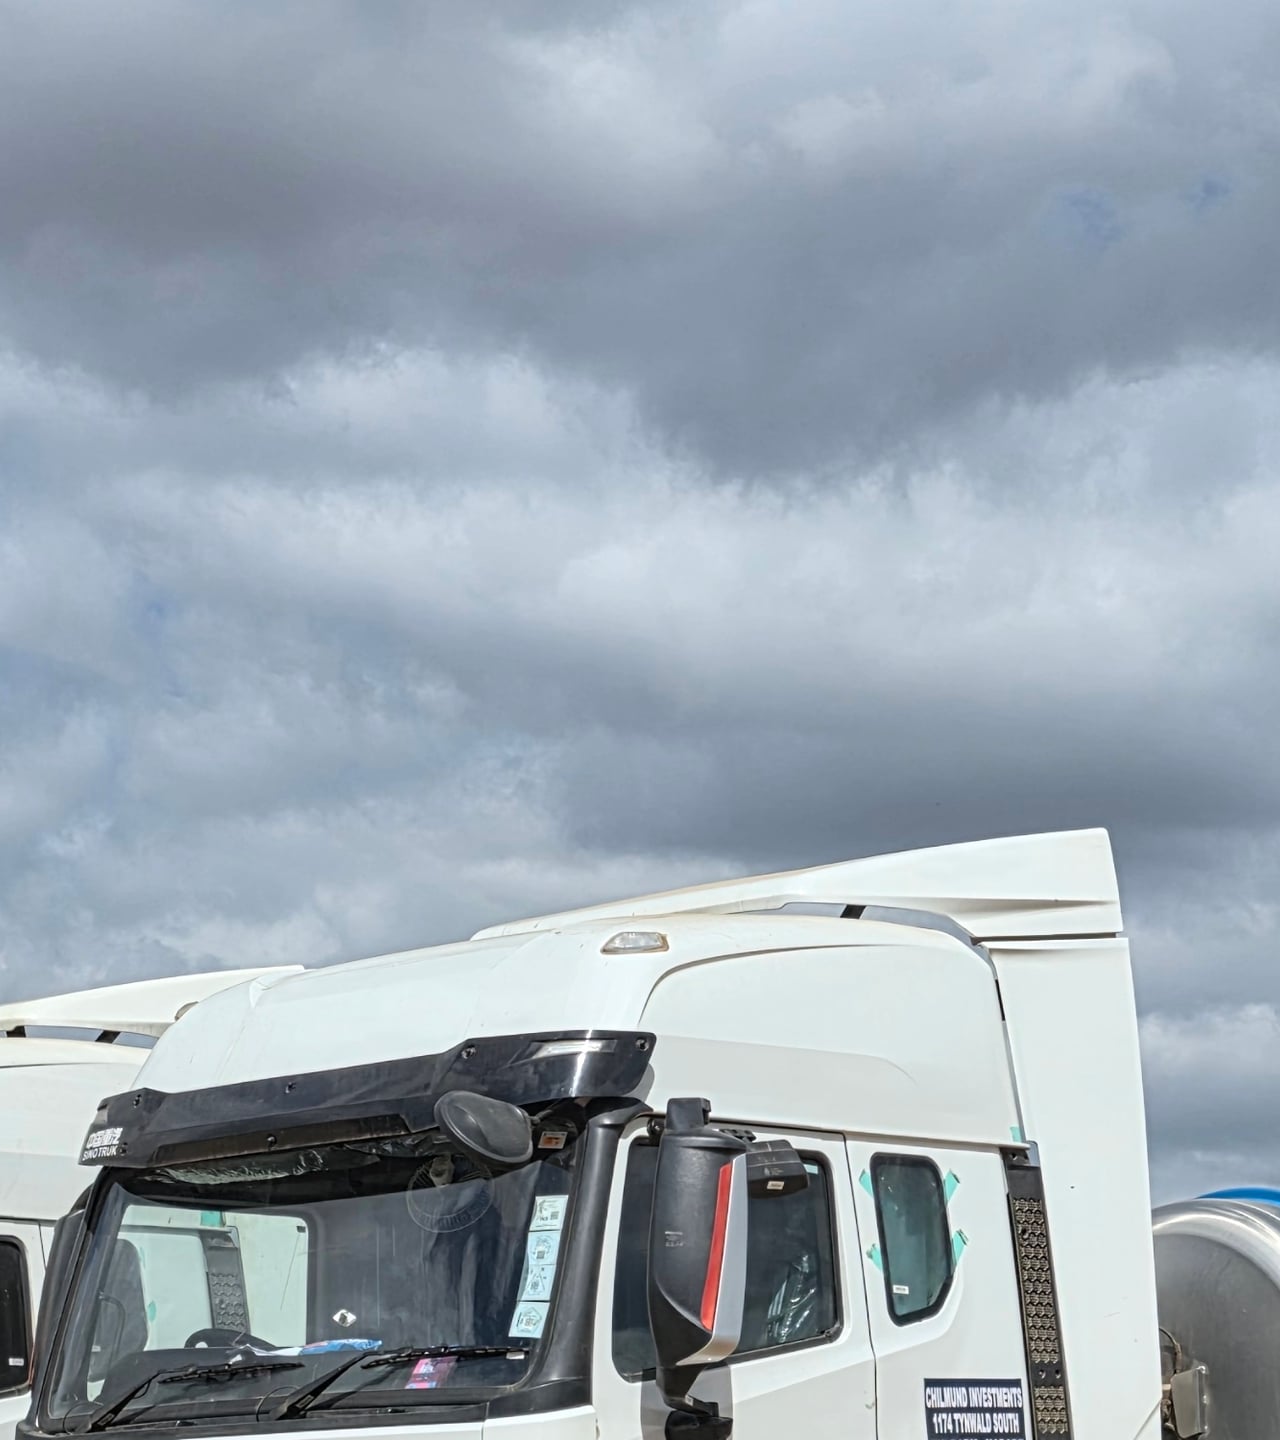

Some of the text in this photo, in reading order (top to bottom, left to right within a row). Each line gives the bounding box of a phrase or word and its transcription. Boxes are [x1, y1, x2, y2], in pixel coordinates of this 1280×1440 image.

[926, 1387, 1022, 1408] CHILMUND INVESTMENTS
[933, 1413, 1020, 1434] 1174 TYNWALD SOUTH
